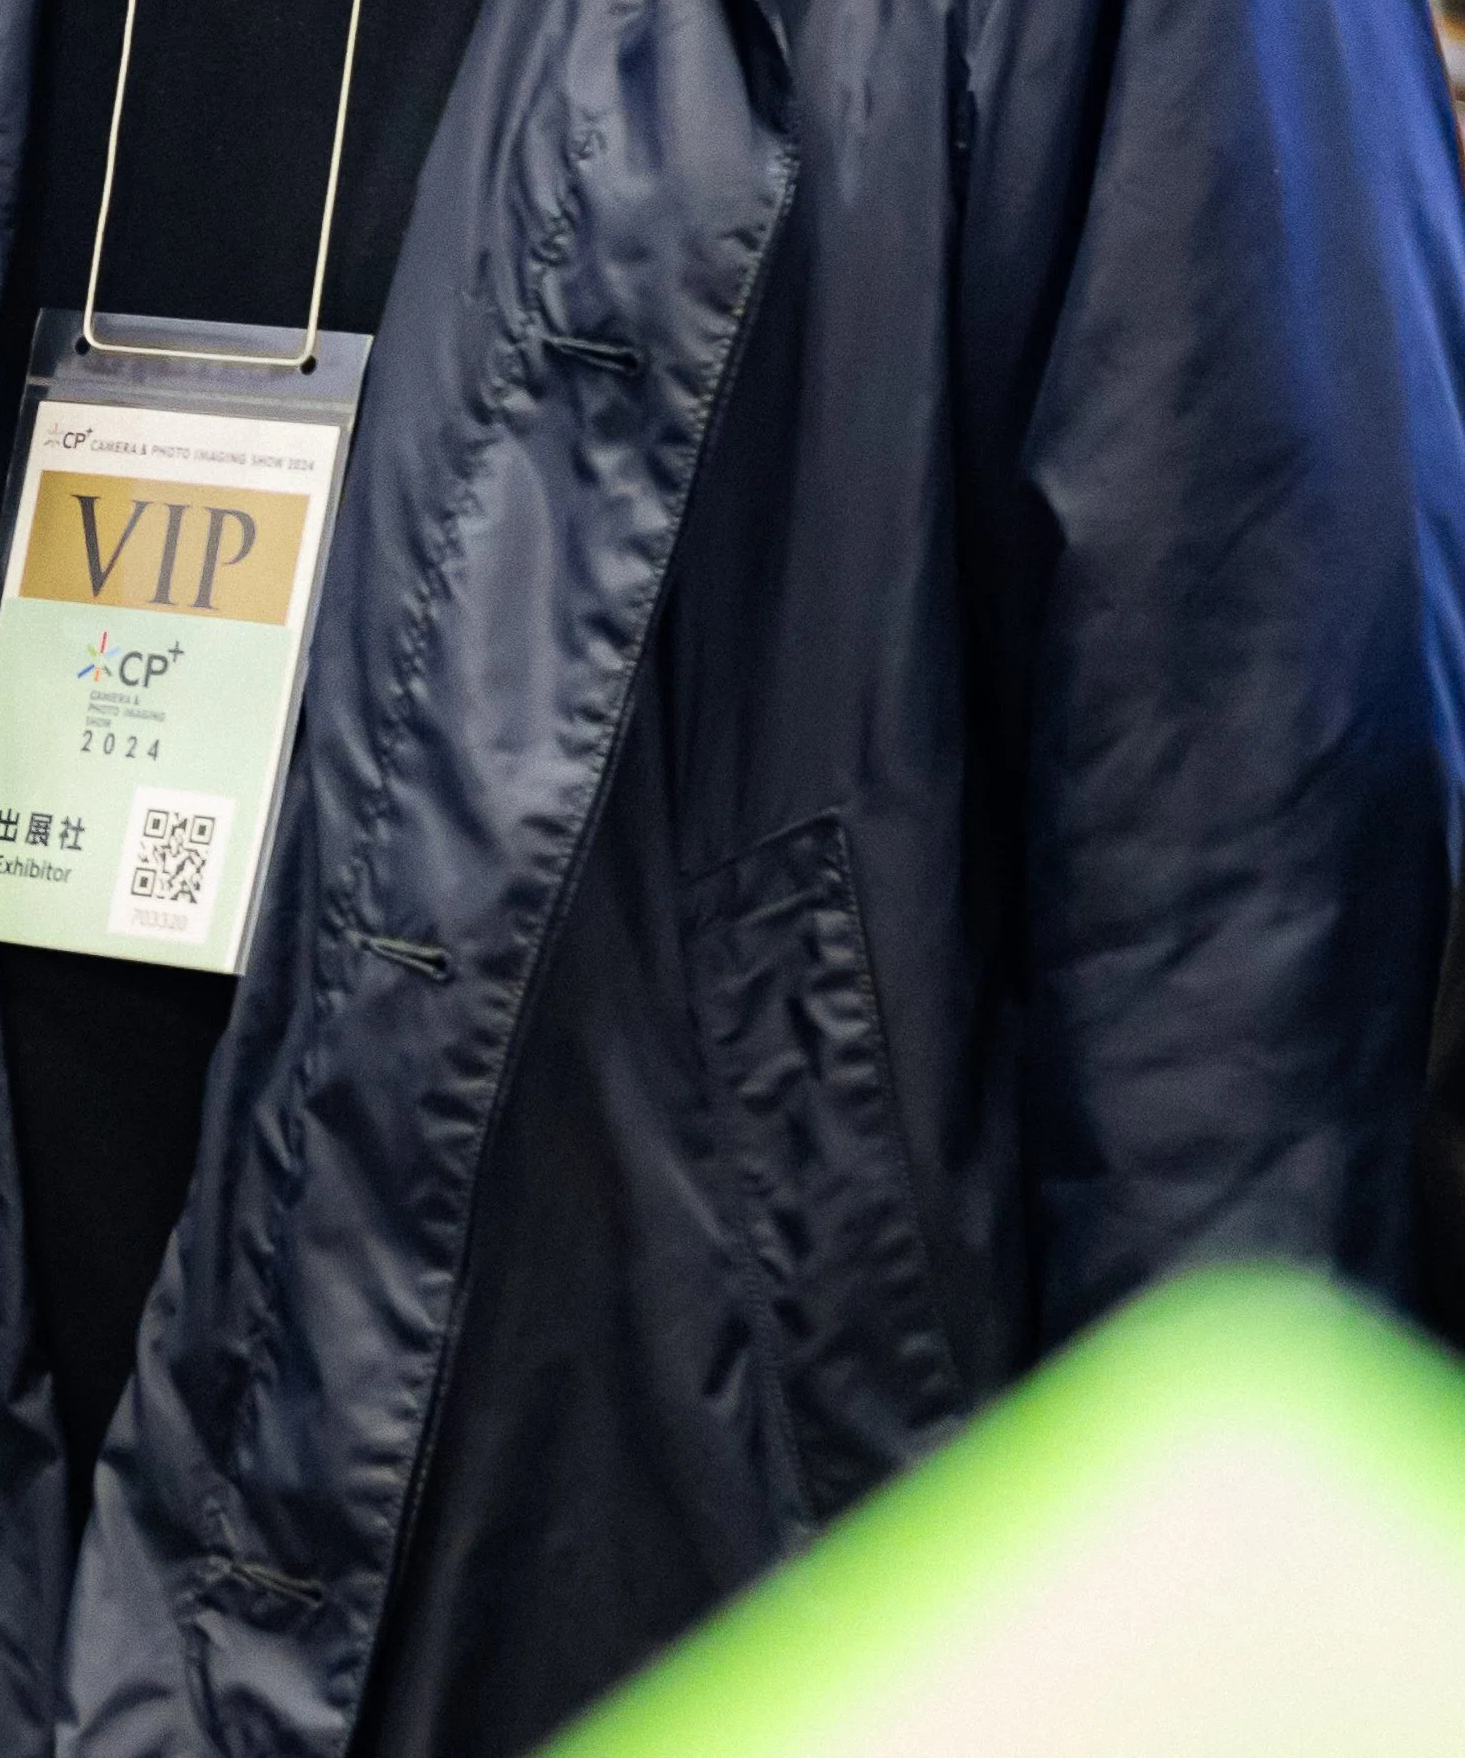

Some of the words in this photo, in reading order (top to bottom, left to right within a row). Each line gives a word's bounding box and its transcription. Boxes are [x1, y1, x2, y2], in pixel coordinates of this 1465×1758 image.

[71, 494, 257, 609] VIP
[119, 640, 184, 688] CP+
[80, 730, 160, 761] 2024
